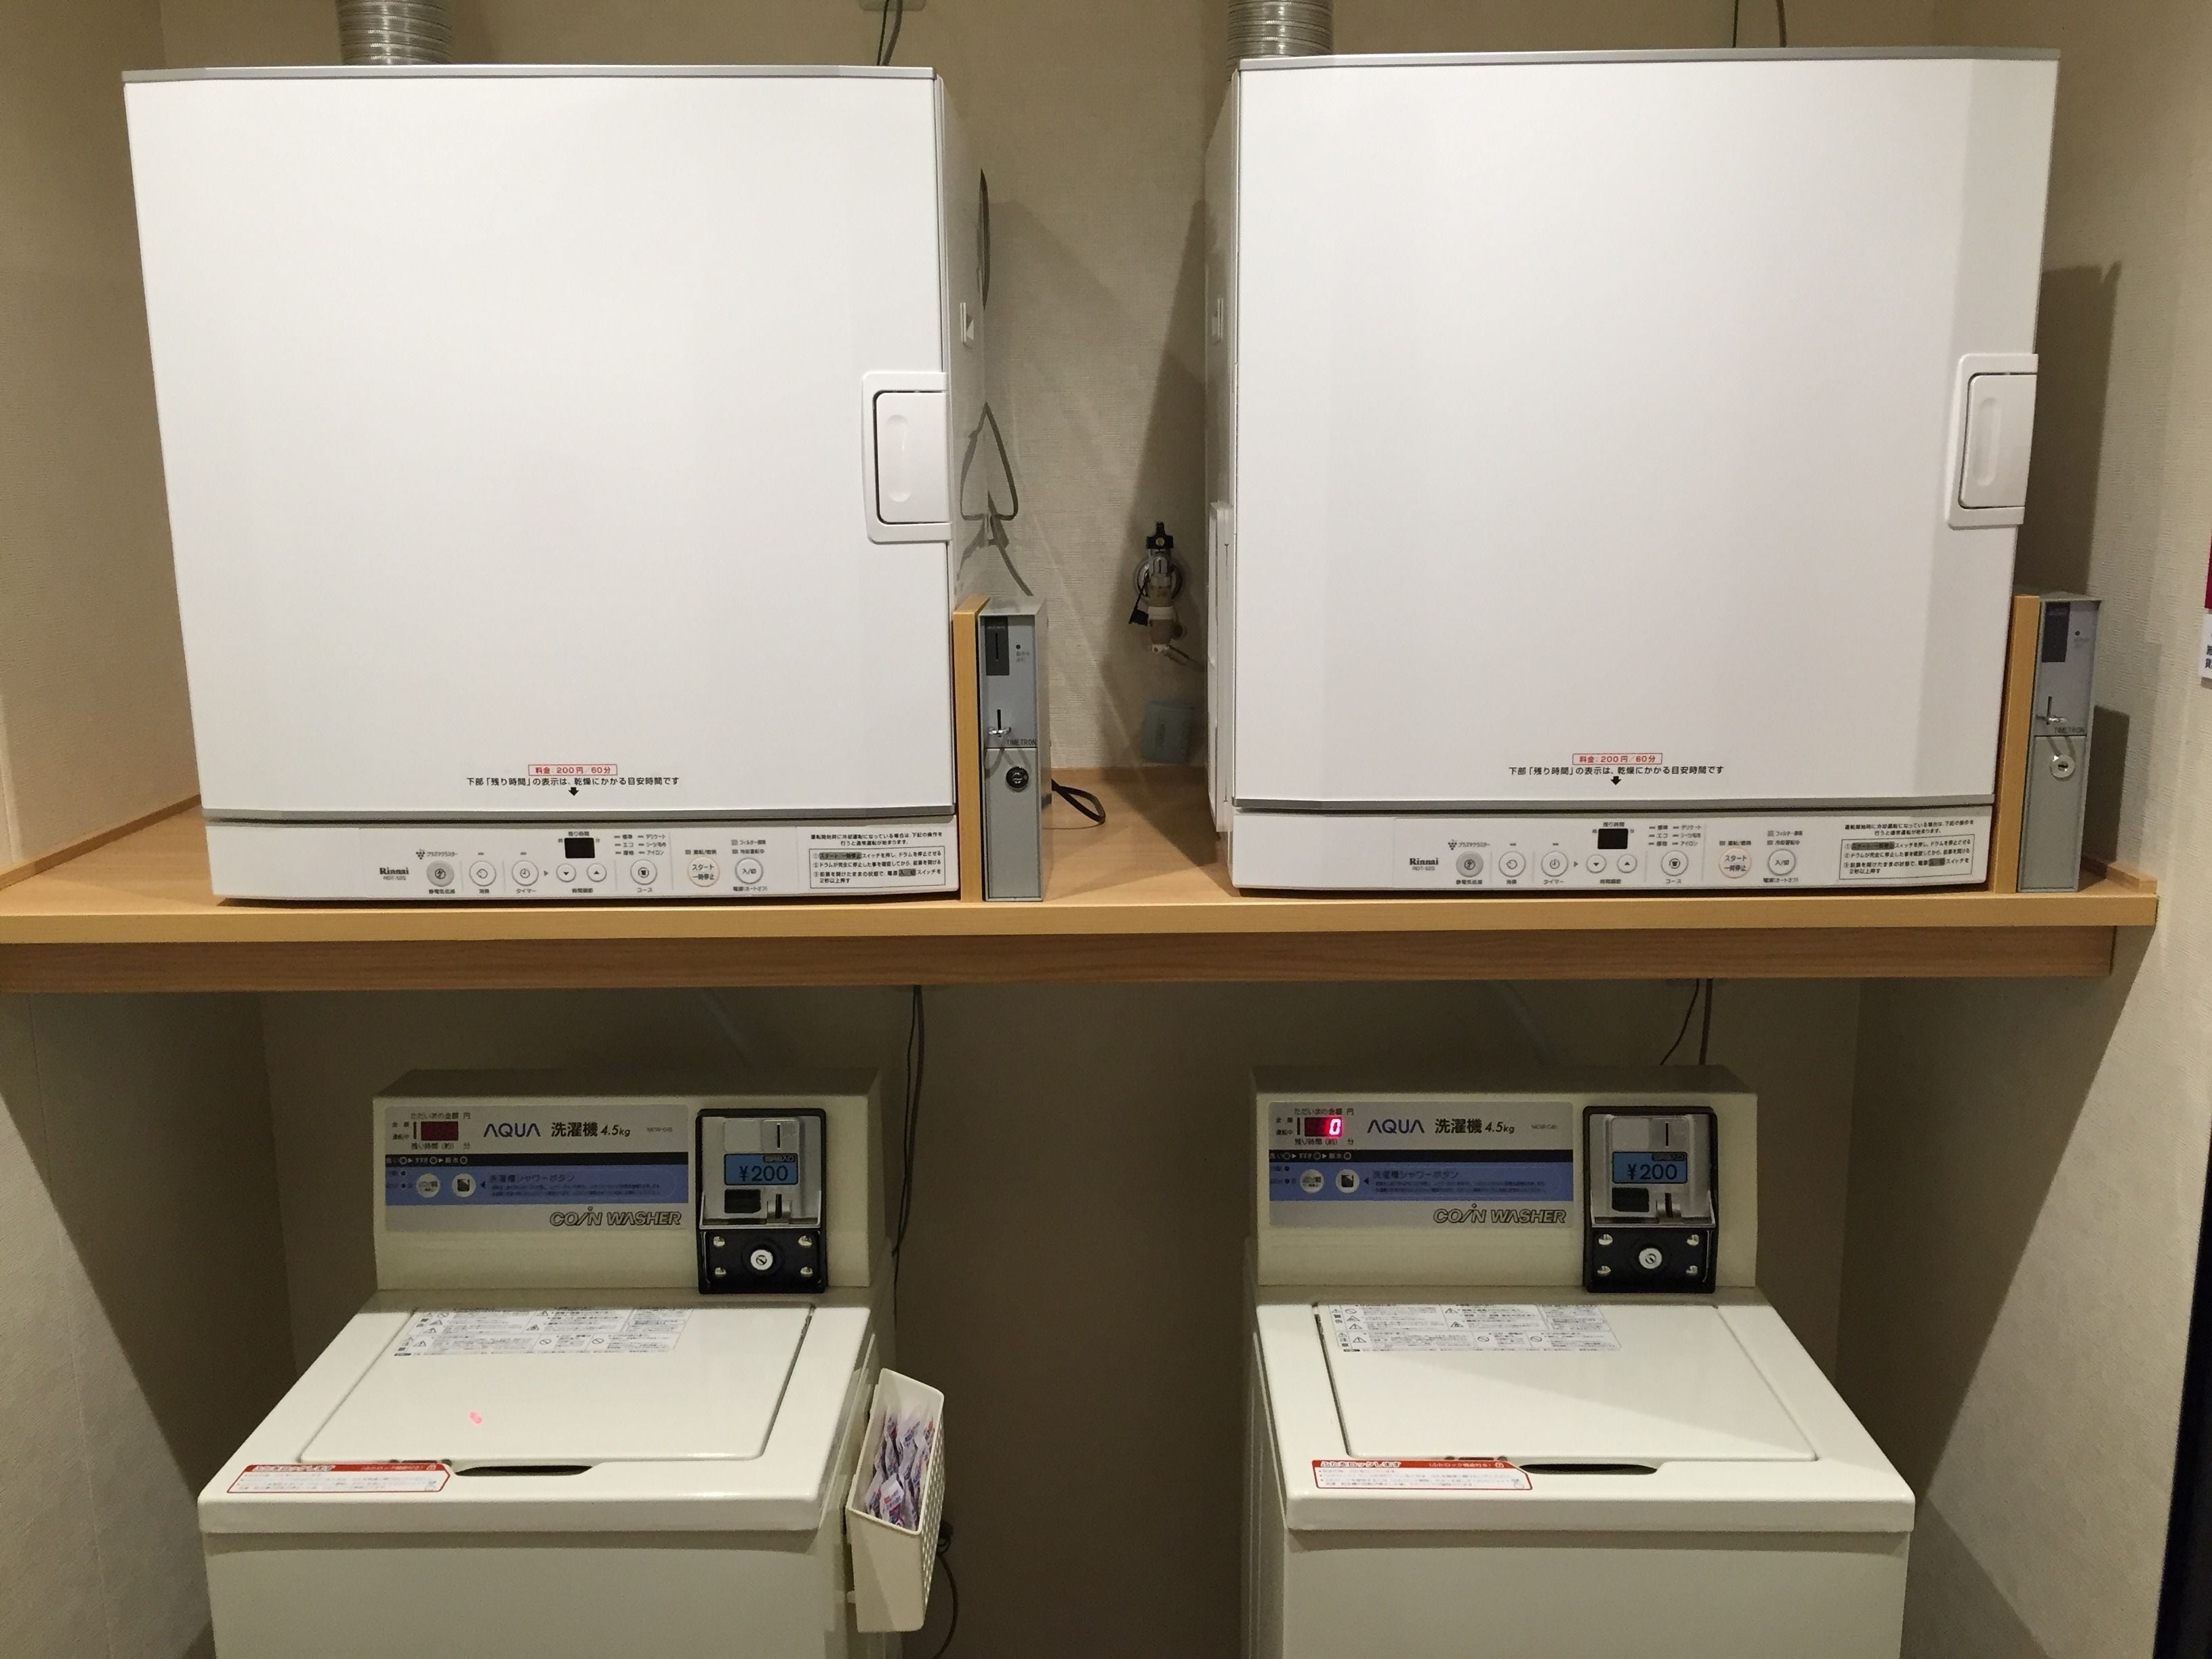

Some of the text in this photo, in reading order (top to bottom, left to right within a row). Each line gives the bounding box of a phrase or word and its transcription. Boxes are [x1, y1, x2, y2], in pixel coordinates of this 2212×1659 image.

[1509, 766, 1723, 775] 下部「残り時間」の表示は、乾燥にかかる目安時間です
[468, 777, 678, 787] 下部「残り時間」の表示は、乾燥にかかる目安時間です
[1410, 857, 1439, 865] Rinnai
[380, 867, 409, 875] Rinnai
[483, 1122, 541, 1138] AQUA
[550, 1122, 631, 1138] 洗濯機 4.5kg
[1328, 1118, 1341, 1135] 0
[1367, 1119, 1425, 1134] AQUA
[1435, 1118, 1515, 1134] 洗濯機 4.5kg
[463, 1142, 470, 1150] 分
[739, 1166, 788, 1182] ¥200
[1627, 1164, 1677, 1180] ¥200
[549, 1206, 682, 1226] COIN WASHER
[1433, 1203, 1566, 1223] COIN WASHER
